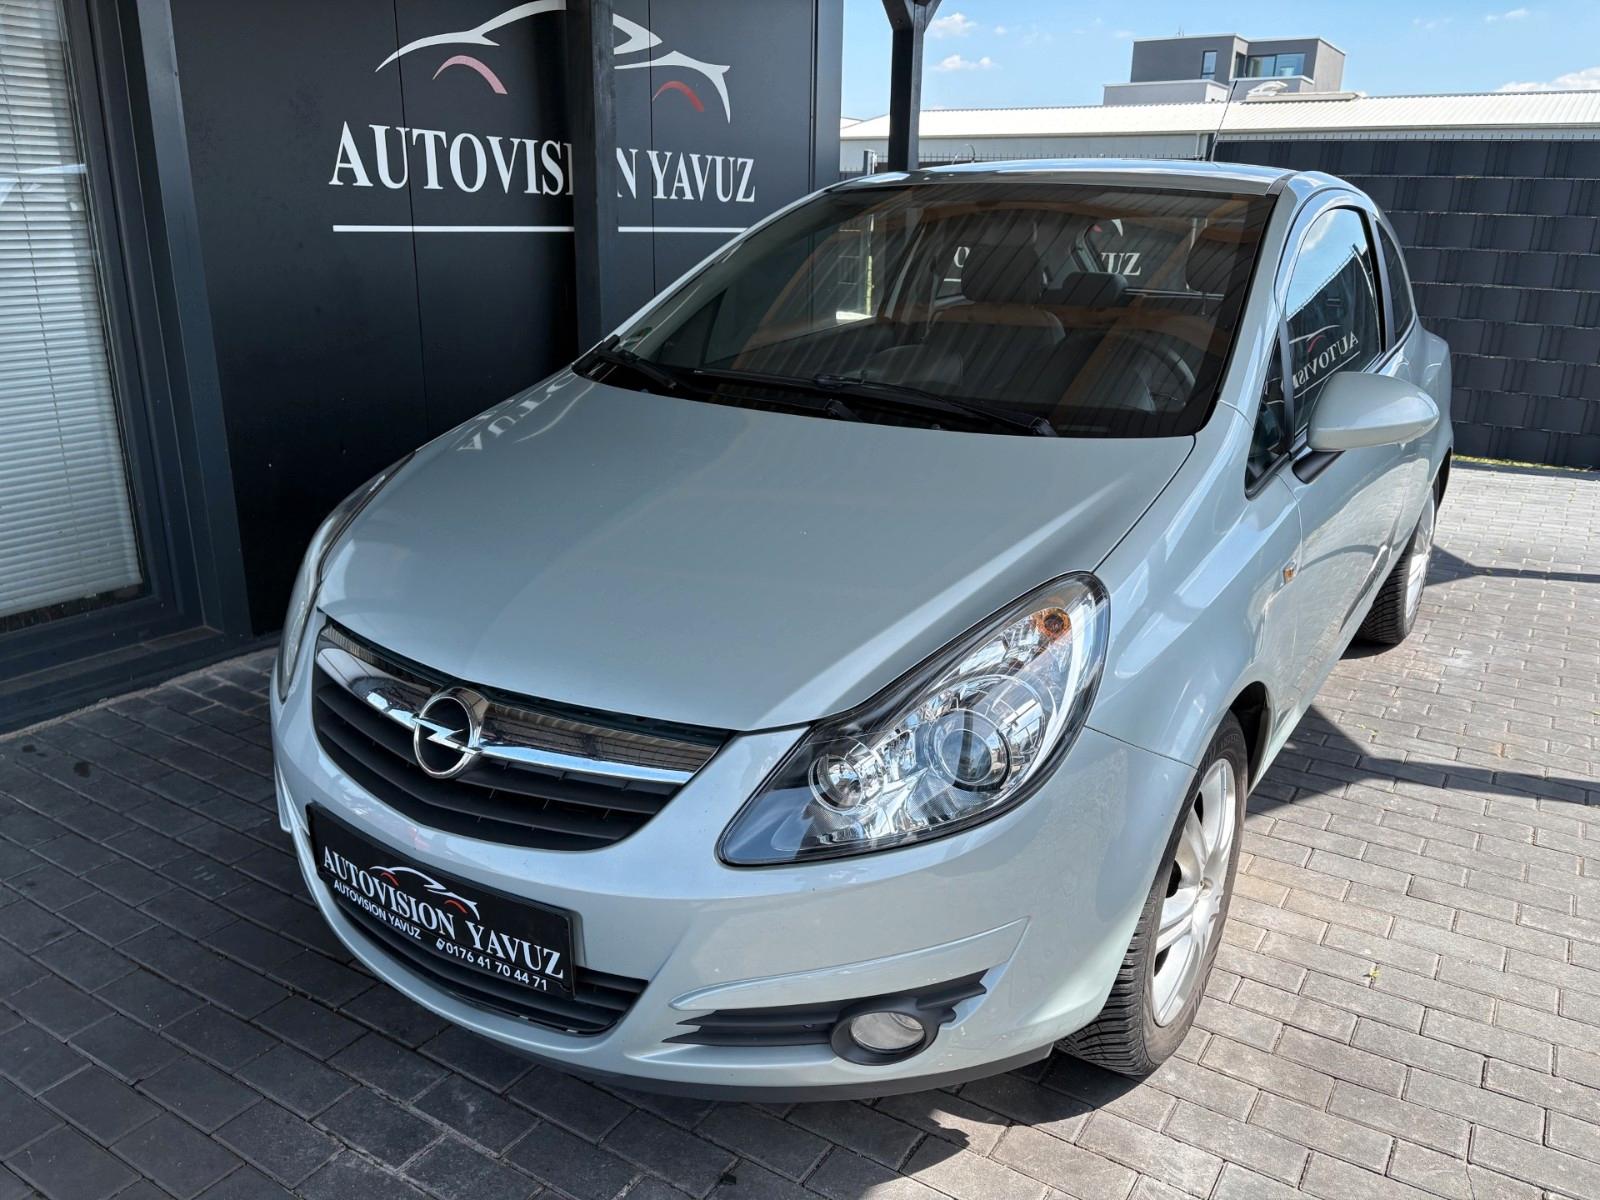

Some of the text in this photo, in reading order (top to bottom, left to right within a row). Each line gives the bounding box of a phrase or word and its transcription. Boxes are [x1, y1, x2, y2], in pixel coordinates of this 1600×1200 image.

[328, 121, 756, 203] AUTOVISIN YAVUZ
[323, 845, 564, 979] AUTOVISION YAVUZ
[333, 879, 547, 991] AUTOVISION YAVUZ 0176 41 70 44 71
